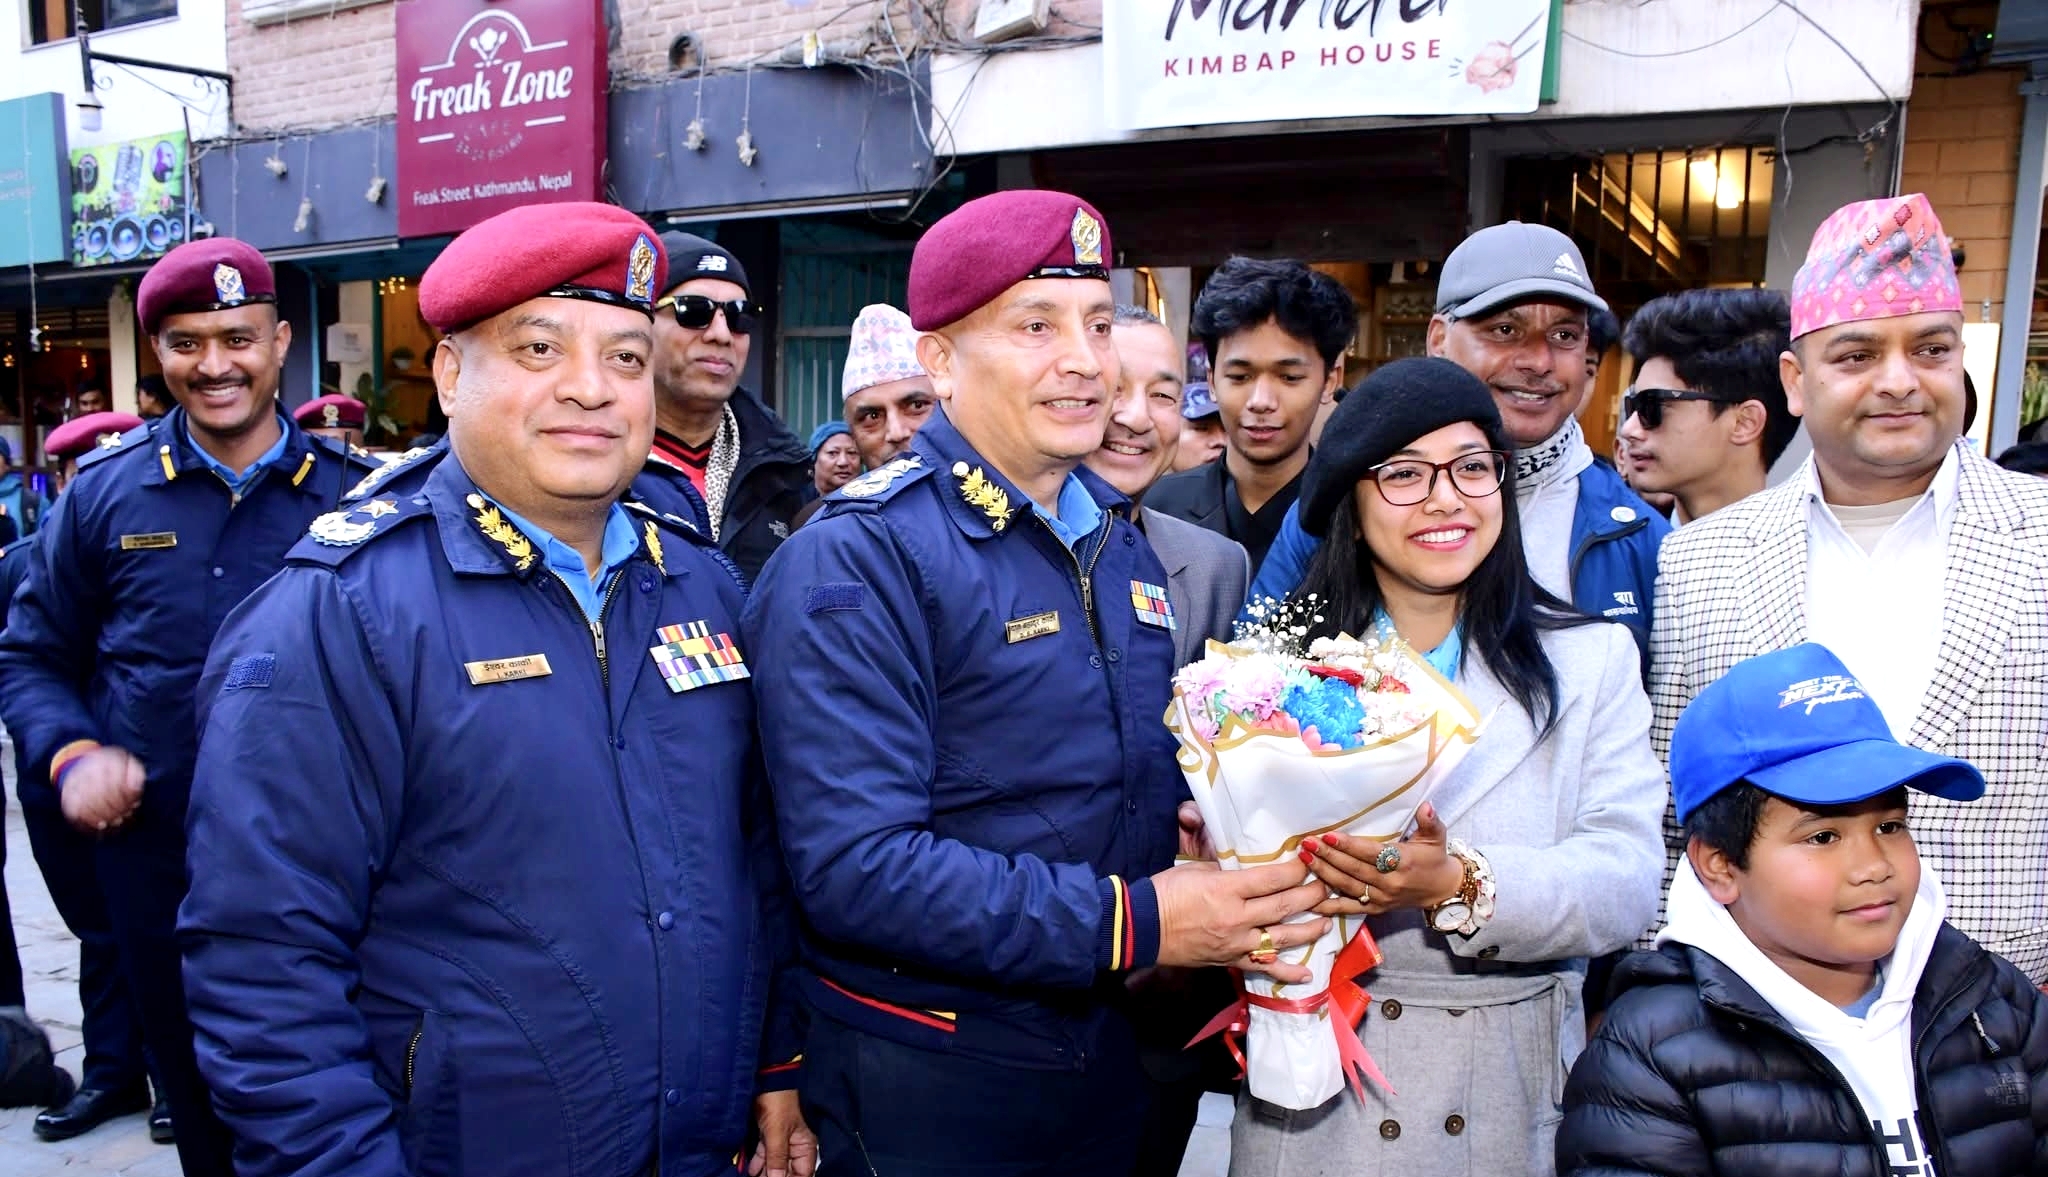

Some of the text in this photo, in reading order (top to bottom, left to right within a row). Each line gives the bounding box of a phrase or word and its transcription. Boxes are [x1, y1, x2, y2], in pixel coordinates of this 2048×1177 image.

[1164, 39, 1441, 78] KIMBAP HOUSE
[411, 61, 573, 122] Freak Zone
[413, 190, 441, 206] Freak
[539, 170, 573, 191] Nepal
